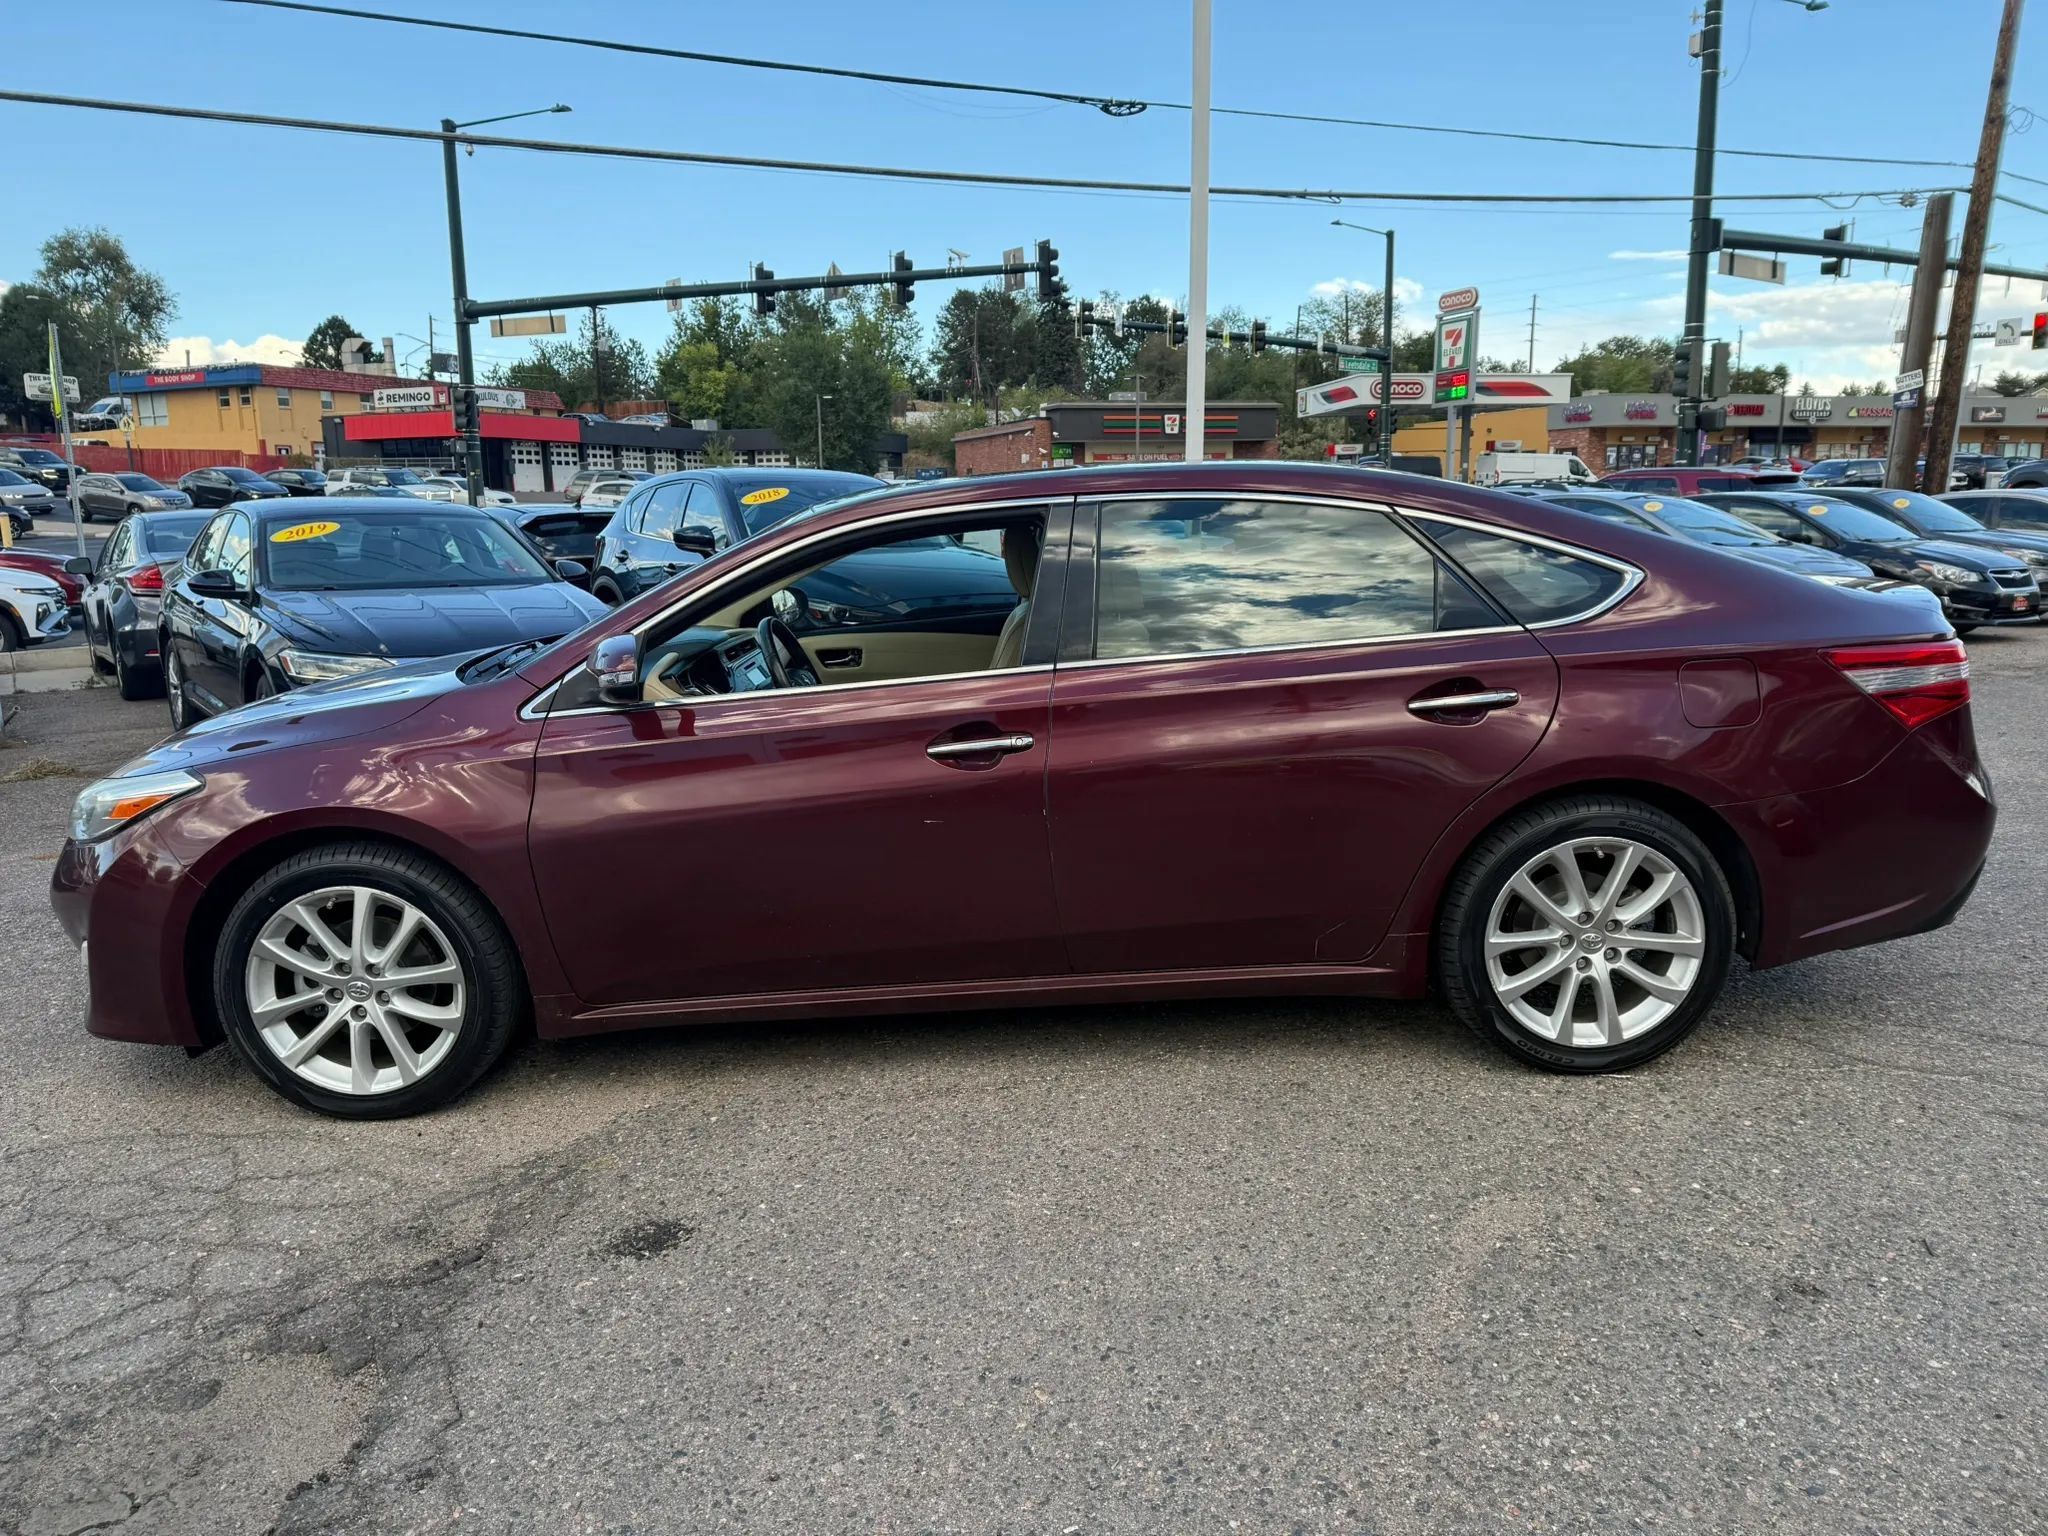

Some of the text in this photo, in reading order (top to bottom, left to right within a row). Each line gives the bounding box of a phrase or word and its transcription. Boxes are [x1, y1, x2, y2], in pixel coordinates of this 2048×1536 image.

[1998, 337, 2017, 345] ONLY
[28, 374, 41, 382] THE
[180, 373, 195, 381] SHOP
[1896, 371, 1921, 384] GUTTERS
[1376, 384, 1422, 395] cnoco
[386, 392, 431, 403] REMINGO
[1796, 398, 1832, 410] FLOYD'S
[1858, 407, 1893, 417] MASSAG
[752, 489, 780, 502] 2018
[284, 523, 327, 540] 2019
